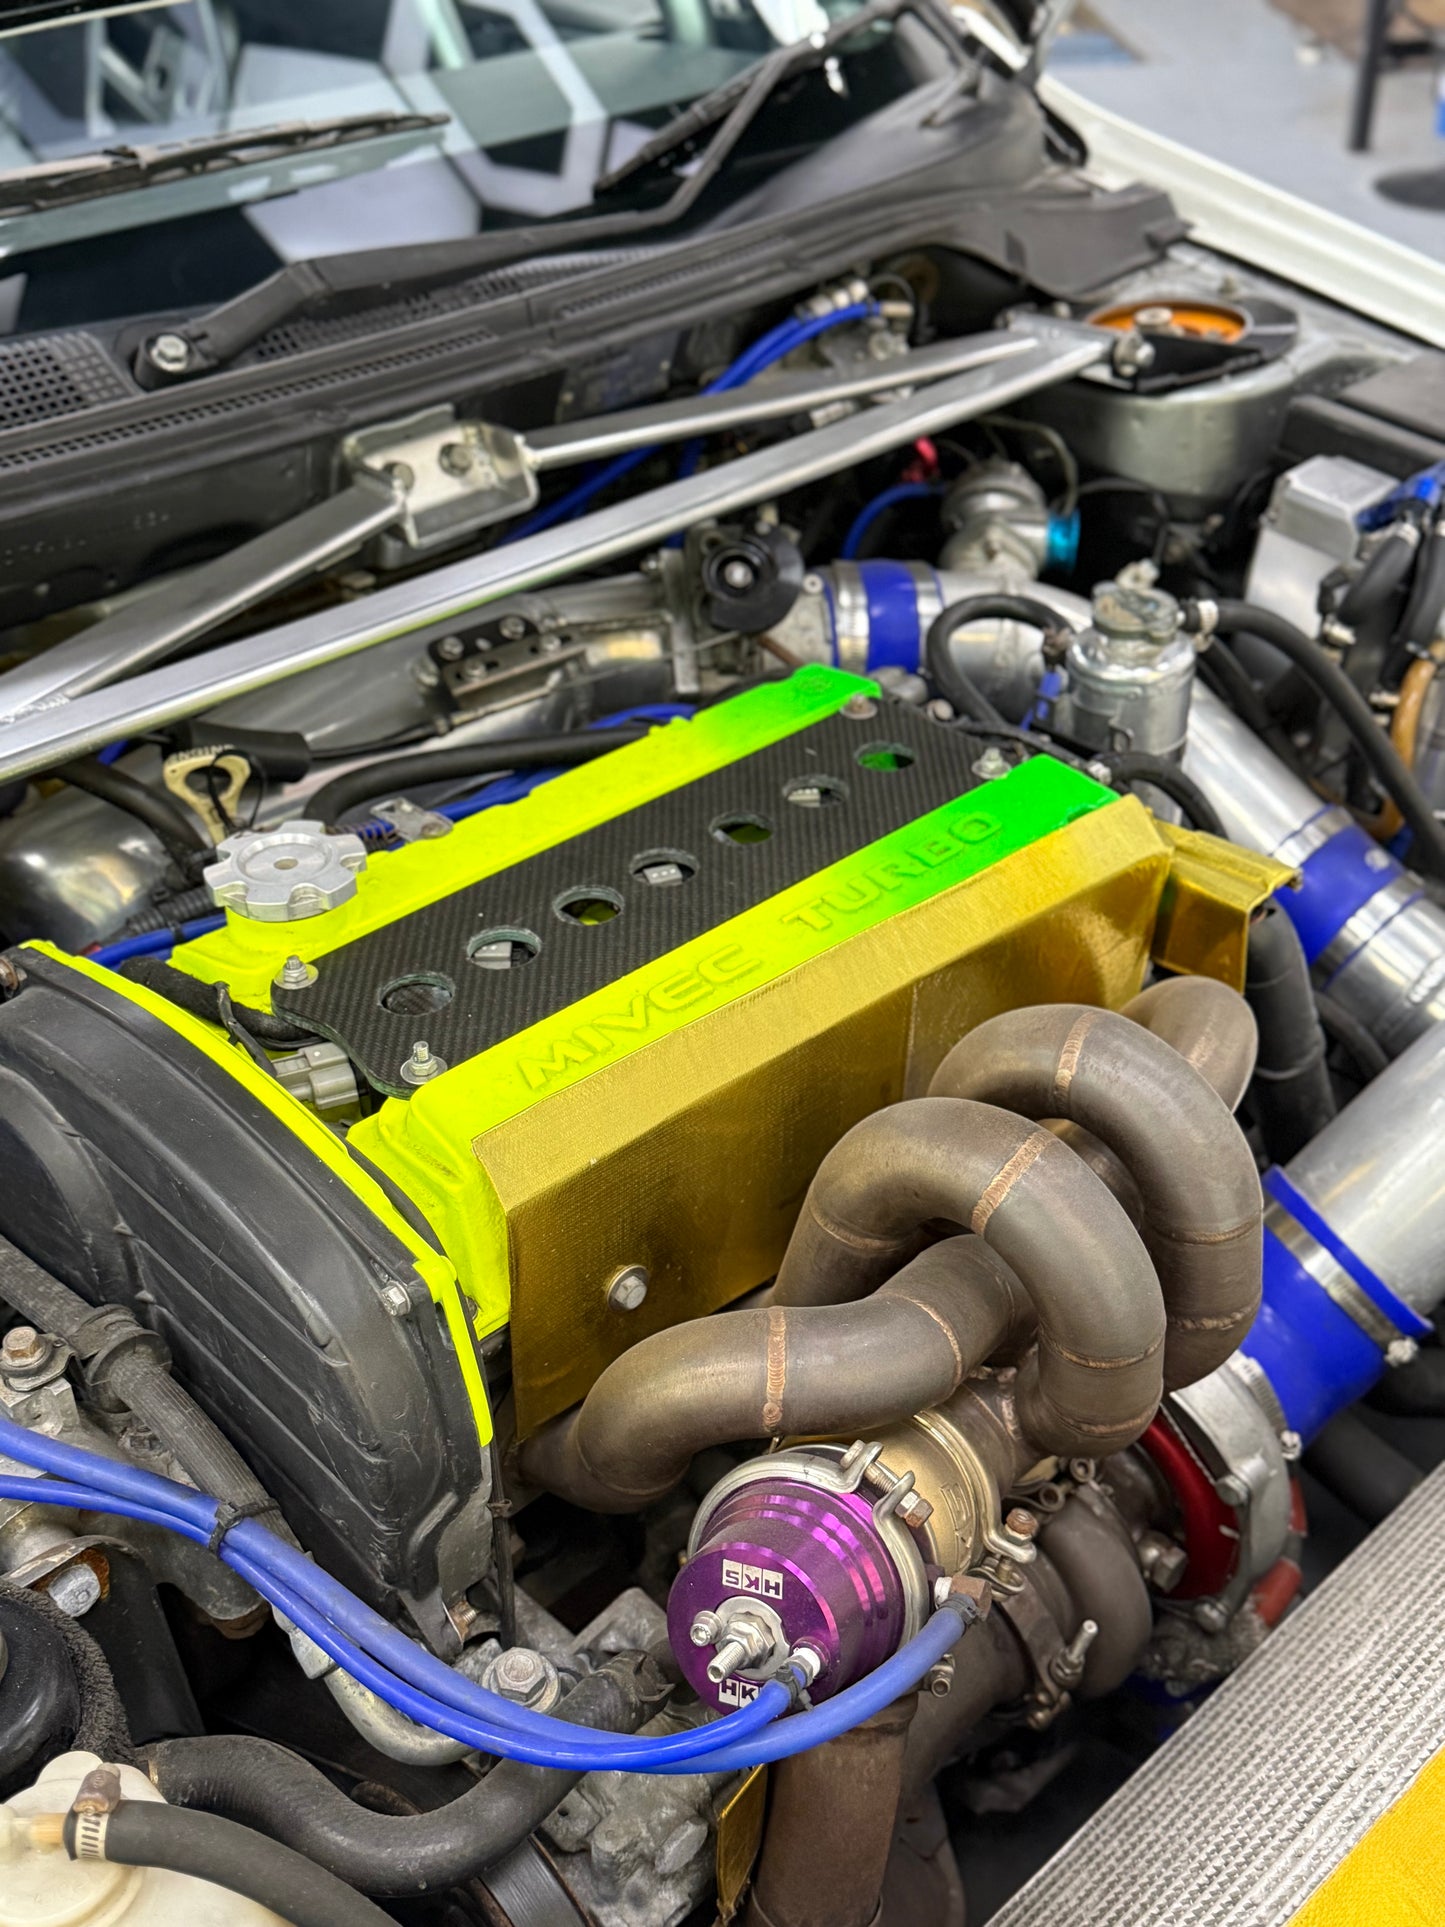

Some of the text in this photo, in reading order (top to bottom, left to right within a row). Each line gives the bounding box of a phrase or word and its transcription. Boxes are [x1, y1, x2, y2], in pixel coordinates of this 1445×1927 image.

[516, 812, 1002, 1090] MIVEC TURBO
[723, 1564, 783, 1598] HKS
[720, 1679, 759, 1704] HK
